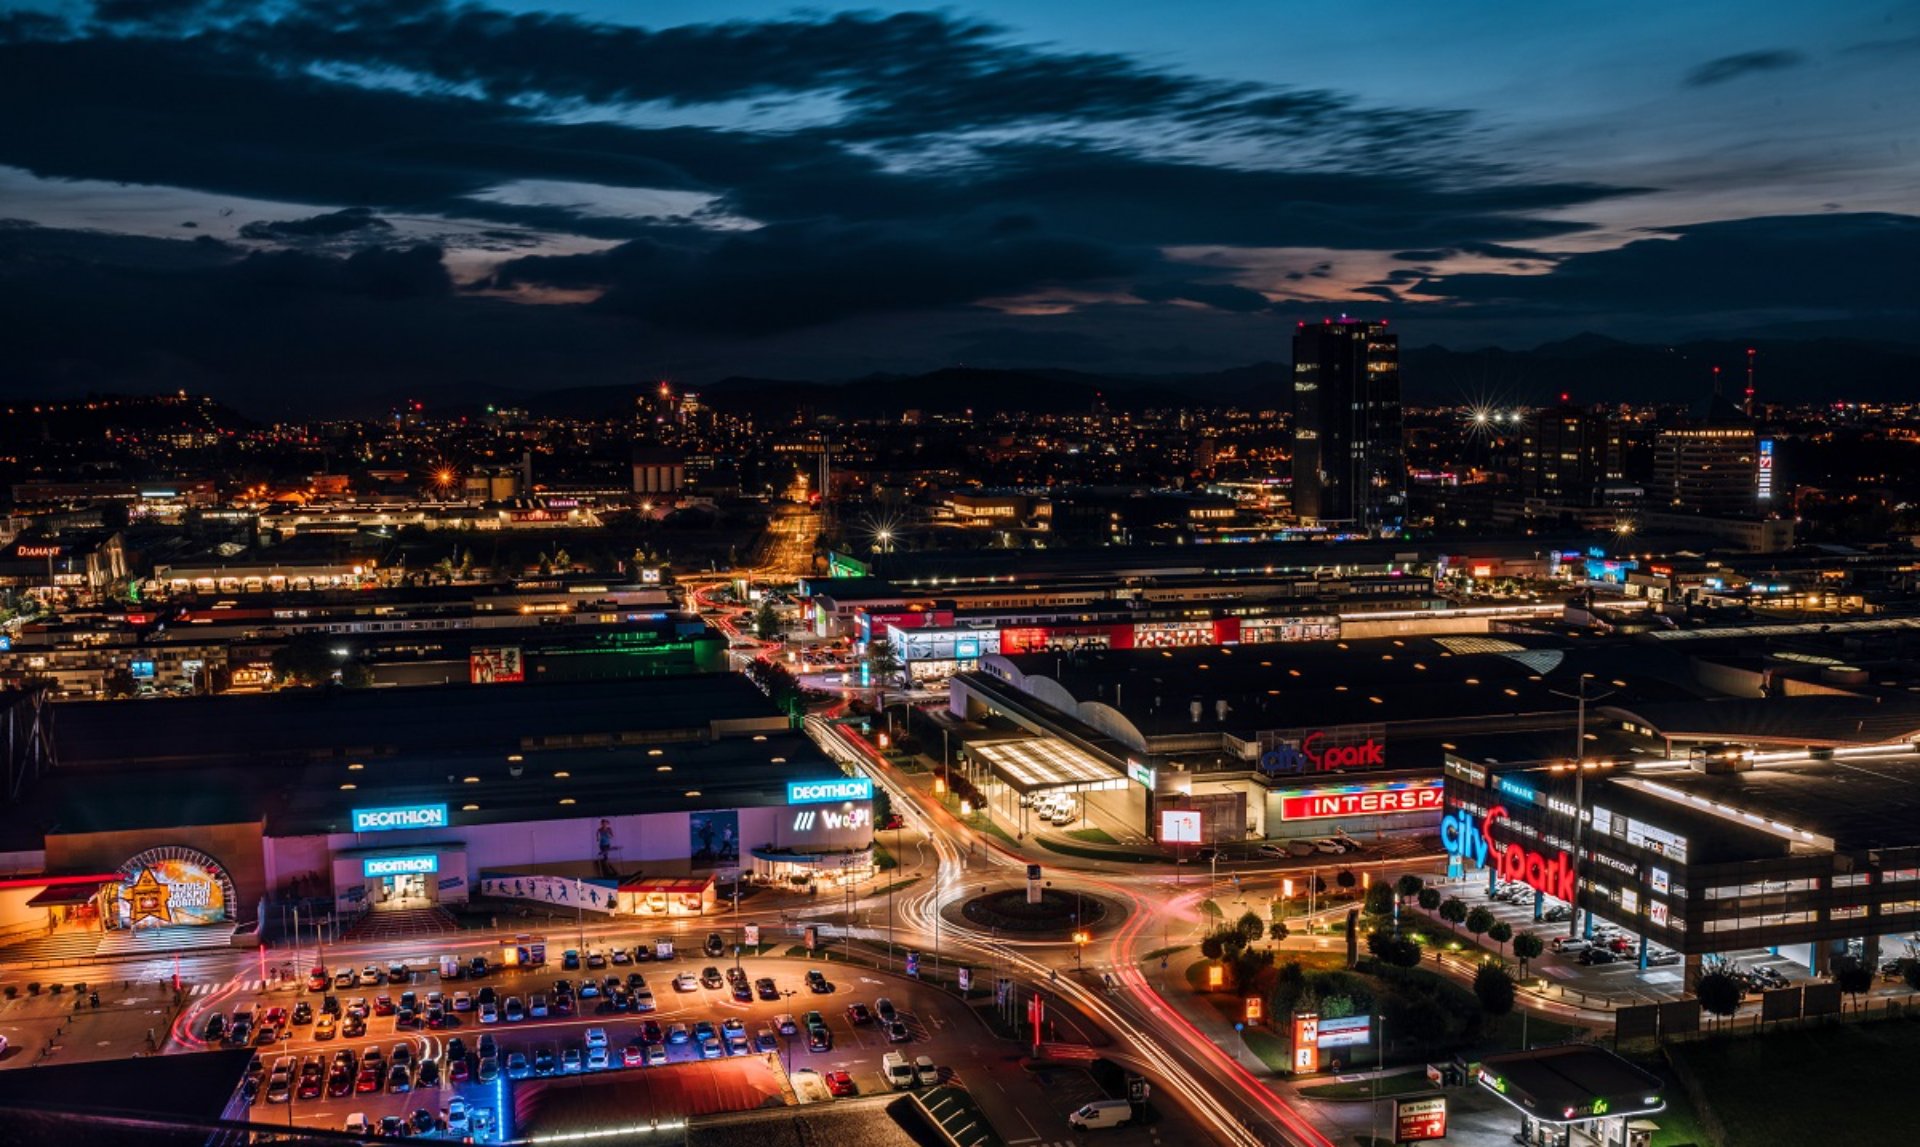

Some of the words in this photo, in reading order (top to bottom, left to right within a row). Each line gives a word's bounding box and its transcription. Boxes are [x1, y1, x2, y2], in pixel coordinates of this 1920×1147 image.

[1261, 743, 1307, 772] city
[1324, 738, 1384, 771] park
[793, 783, 868, 800] DECATHLON
[1501, 780, 1534, 800] PRIMARK
[358, 808, 442, 828] DECATHLON
[1547, 797, 1592, 822] RESERED
[368, 858, 433, 874] DECATHLON
[1441, 810, 1487, 868] city
[1505, 843, 1576, 903] park
